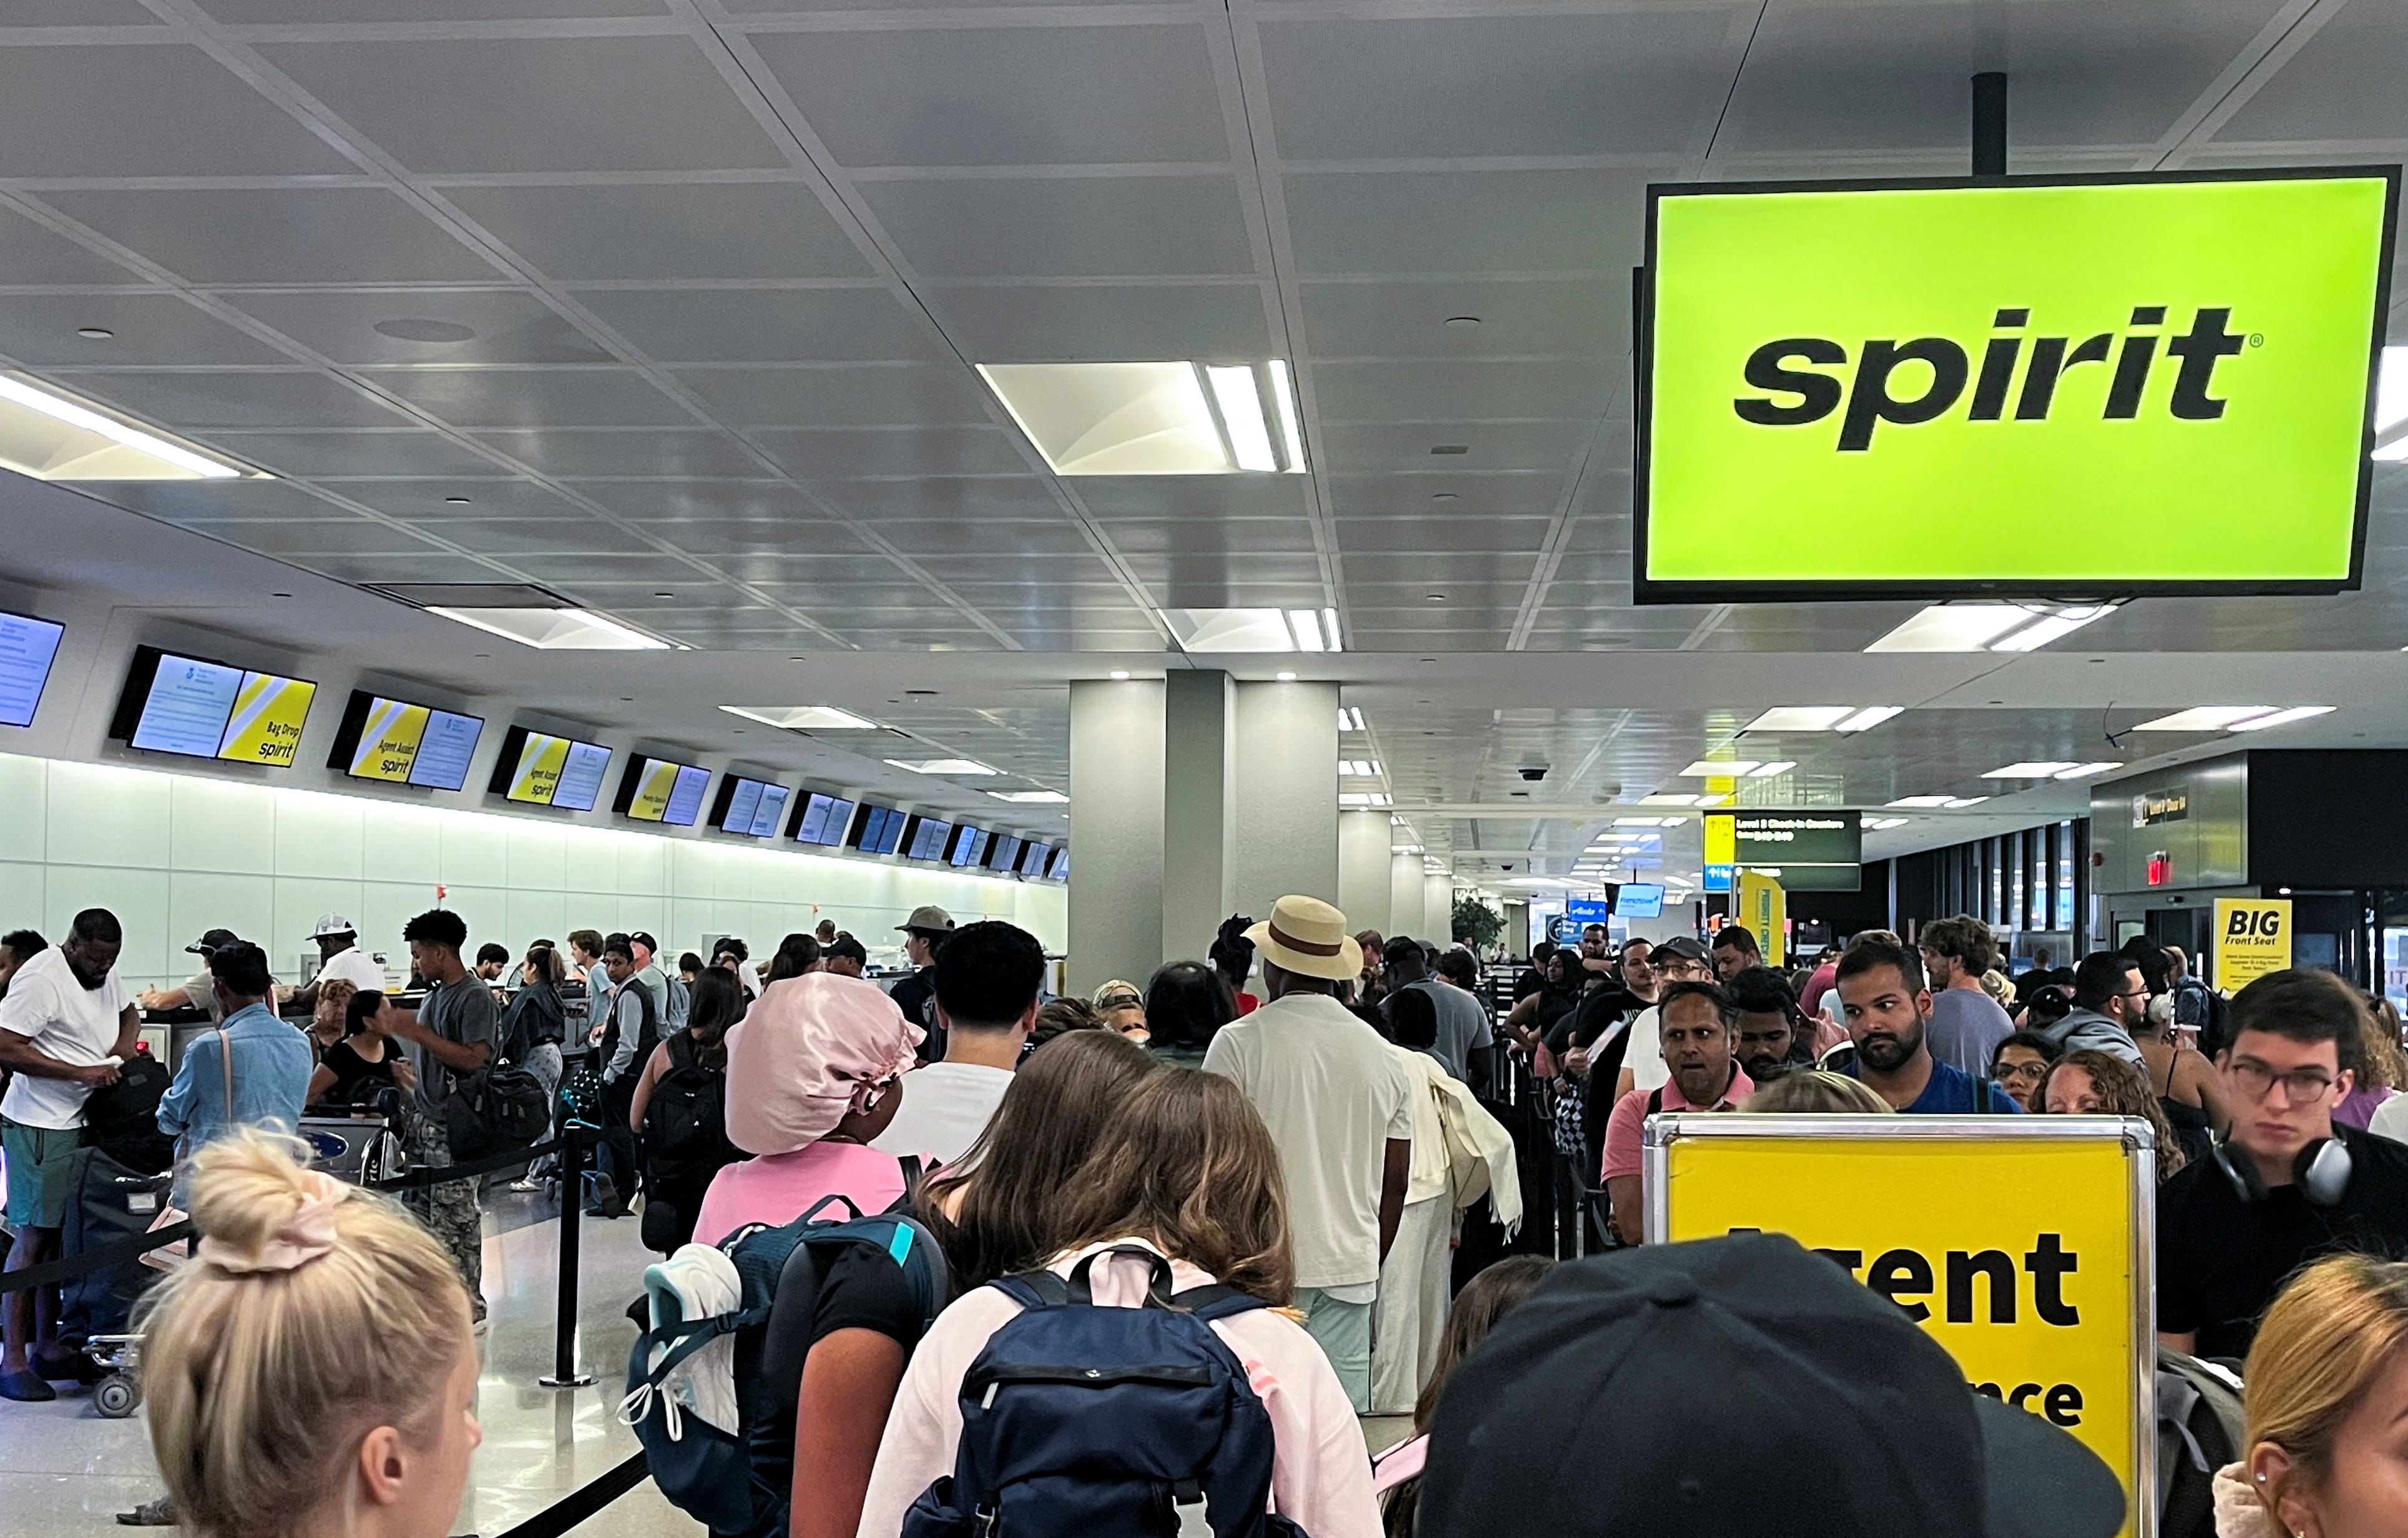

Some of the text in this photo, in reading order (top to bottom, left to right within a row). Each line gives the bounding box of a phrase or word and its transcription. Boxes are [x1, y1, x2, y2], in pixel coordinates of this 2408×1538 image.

[1733, 306, 2244, 451] spirit
[267, 721, 300, 739] Bag Drop
[259, 741, 293, 759] spirit
[381, 758, 409, 775] spirit
[531, 784, 552, 798] spirit
[2227, 910, 2279, 936] BIG
[2225, 936, 2276, 945] Front Seat
